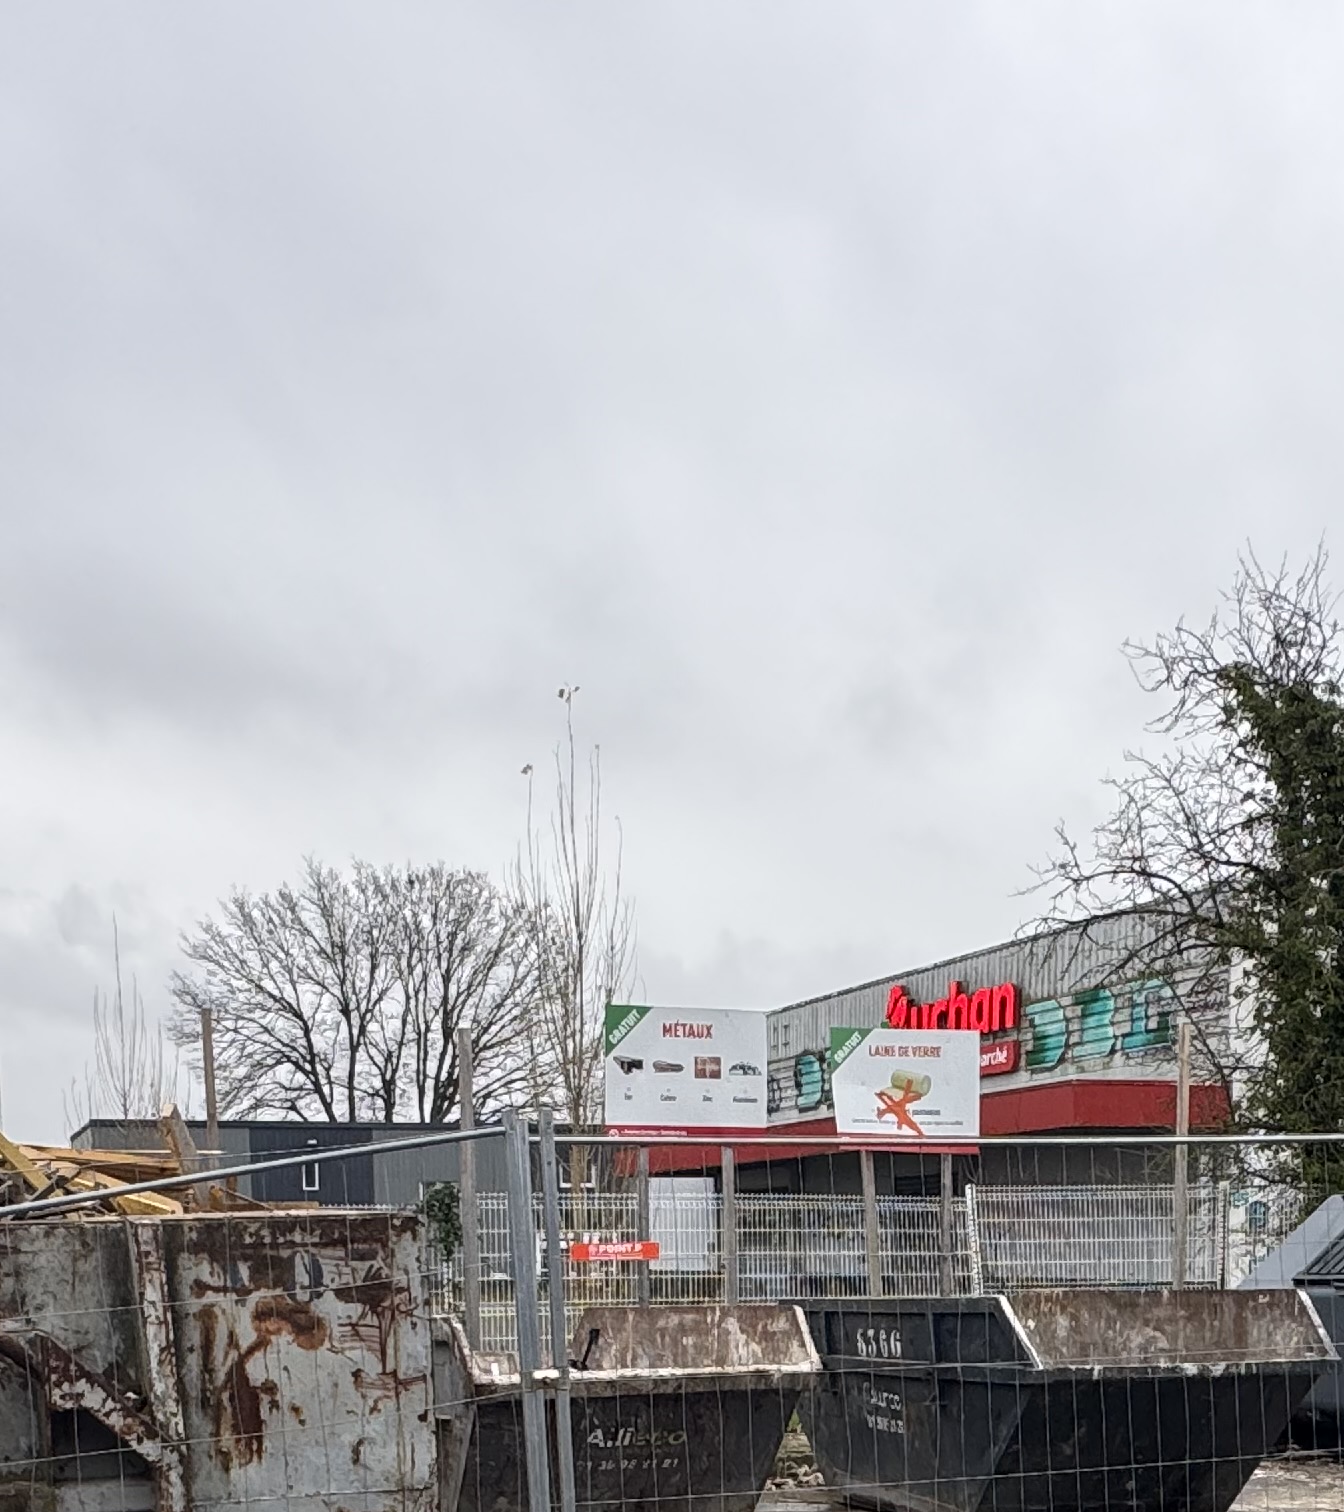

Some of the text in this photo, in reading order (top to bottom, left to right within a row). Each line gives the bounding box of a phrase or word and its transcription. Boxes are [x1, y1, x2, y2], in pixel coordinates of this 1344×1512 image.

[608, 1008, 641, 1045] GRATUIT
[662, 1020, 714, 1039] MÉTAUX
[834, 1031, 862, 1064] GRATUIT
[898, 1046, 909, 1057] DE
